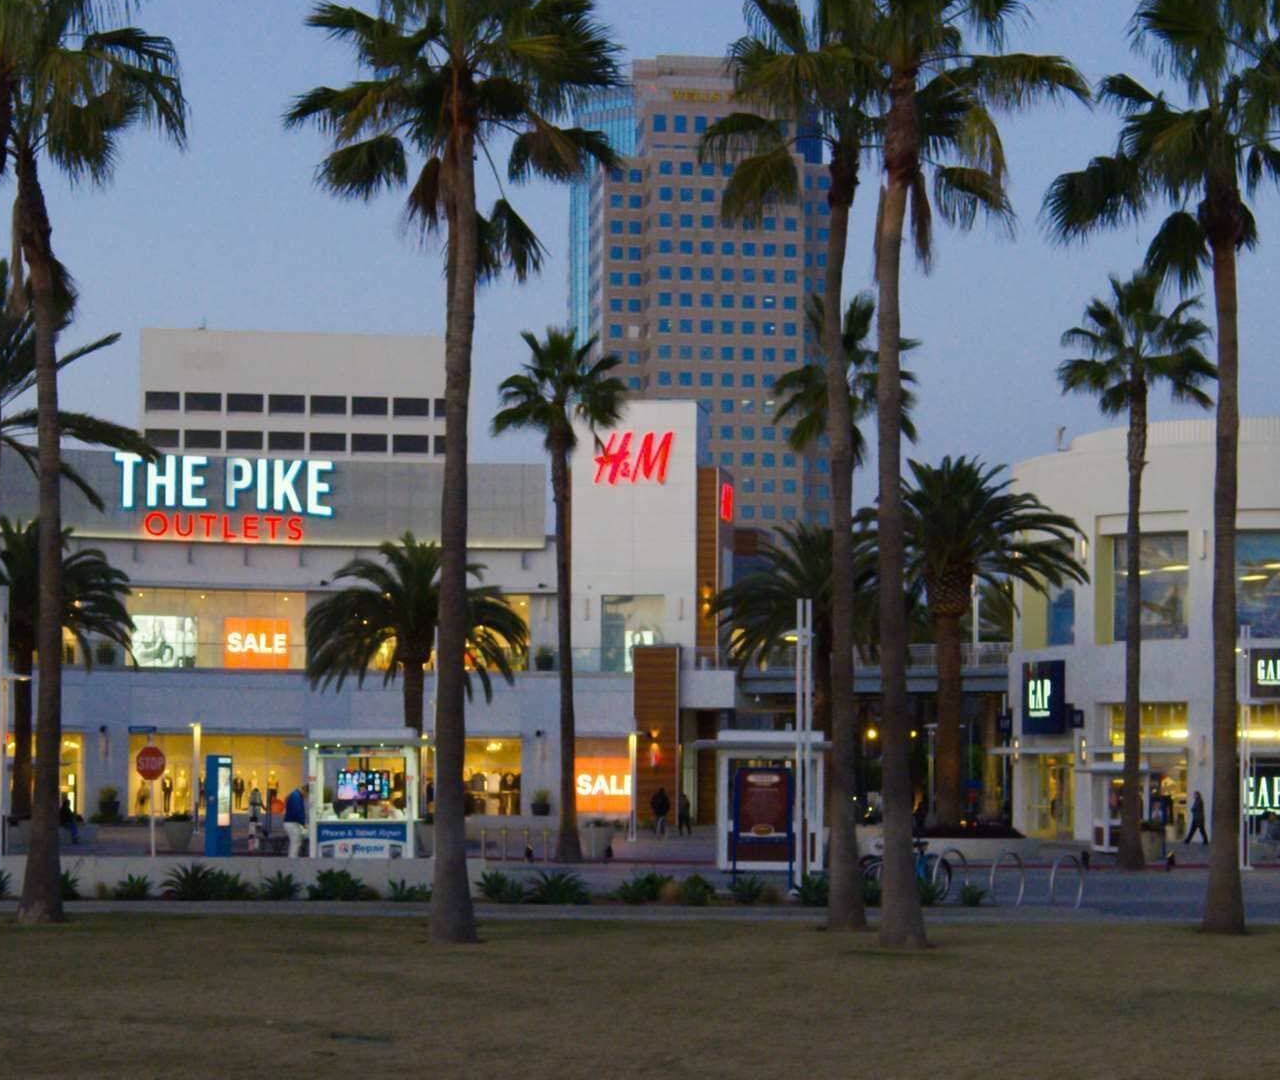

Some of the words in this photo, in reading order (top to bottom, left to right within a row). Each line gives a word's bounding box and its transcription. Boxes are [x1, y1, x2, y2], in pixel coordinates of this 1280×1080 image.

[593, 431, 673, 485] H&M
[113, 451, 209, 508] THE
[225, 457, 334, 517] PIKE
[144, 512, 304, 542] OUTLETS
[227, 632, 287, 653] SALE
[1028, 679, 1051, 709] GAP
[138, 756, 164, 769] STOP
